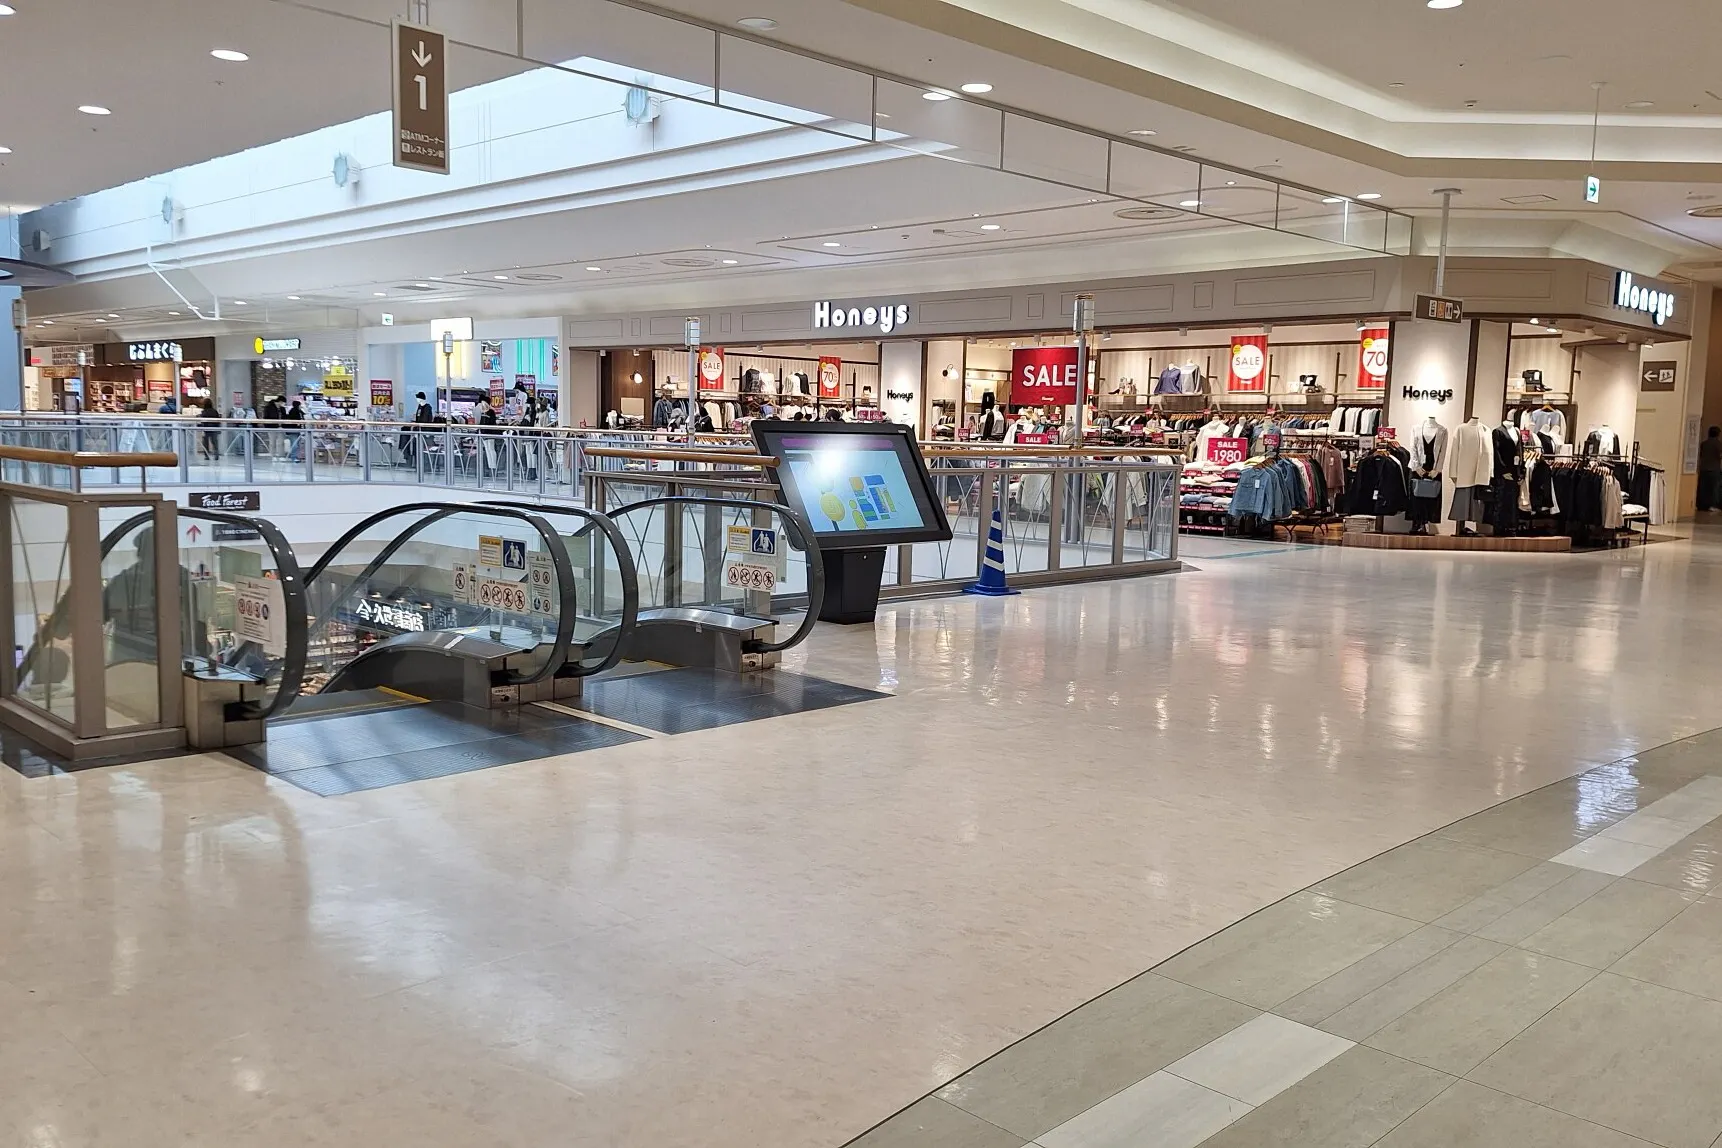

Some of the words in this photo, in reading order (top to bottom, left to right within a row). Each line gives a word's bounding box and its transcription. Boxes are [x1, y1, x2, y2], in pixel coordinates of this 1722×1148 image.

[413, 74, 428, 111] 1
[1616, 270, 1675, 326] Honeys
[814, 301, 910, 333] Honeys
[703, 361, 721, 371] SALE
[1235, 356, 1261, 366] SALE
[1022, 364, 1077, 387] SALE
[887, 389, 914, 403] Honeys
[1402, 385, 1453, 402] Honeys
[1217, 441, 1239, 449] SALE
[201, 494, 222, 507] Food
[222, 493, 249, 507] Forest
